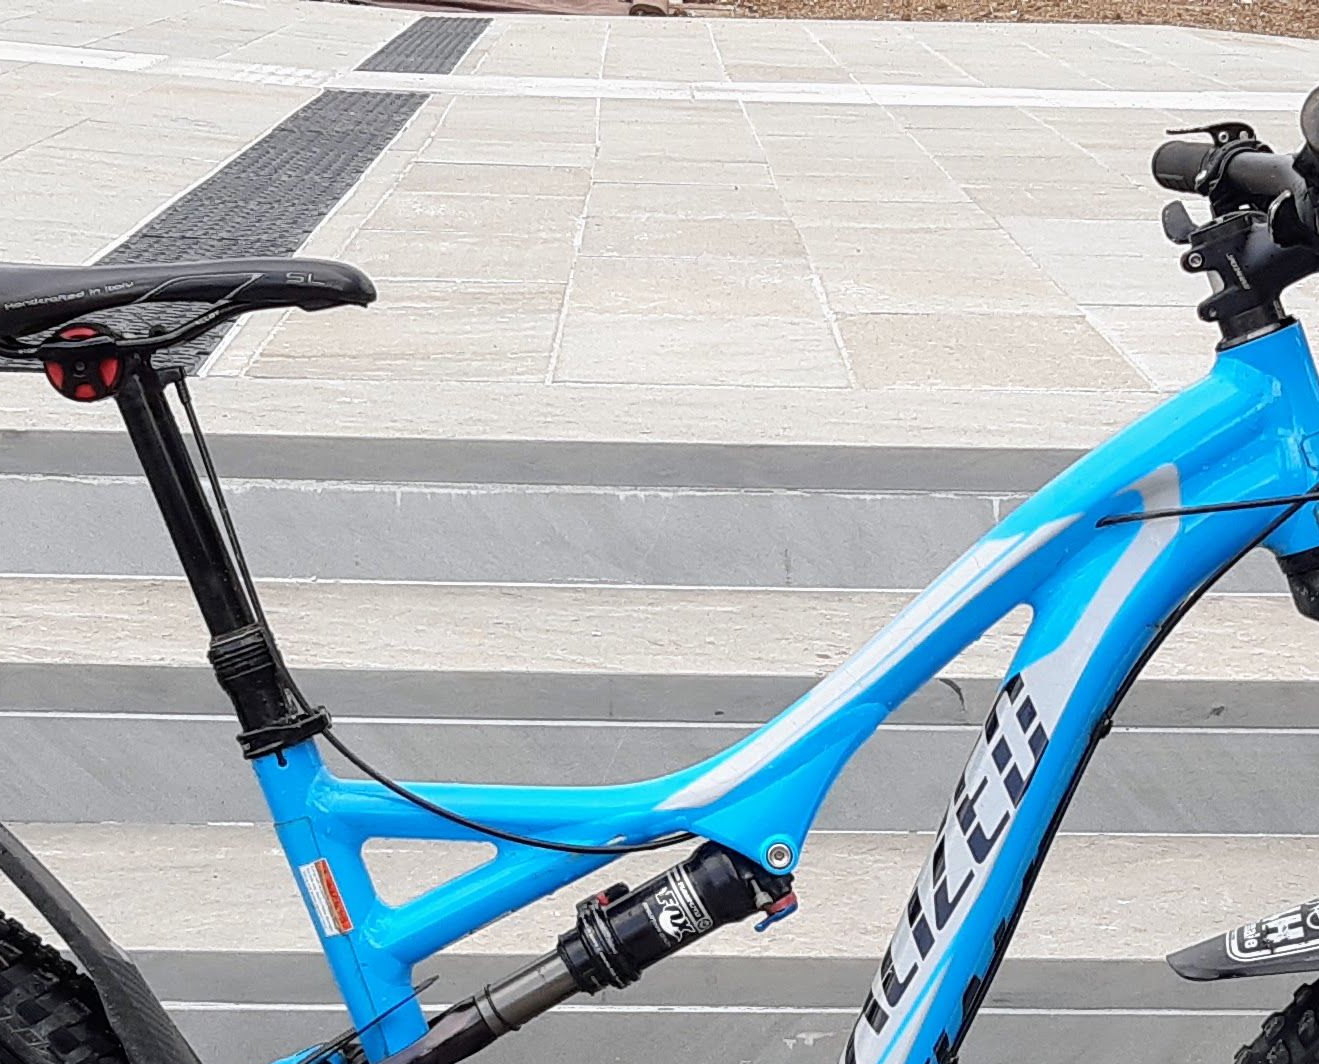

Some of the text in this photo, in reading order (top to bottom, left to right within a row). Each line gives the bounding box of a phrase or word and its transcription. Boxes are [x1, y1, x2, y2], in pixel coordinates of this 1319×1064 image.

[285, 271, 326, 286] SL
[3, 290, 85, 311] Handcrafted
[88, 288, 101, 297] in
[655, 886, 696, 943] FOX
